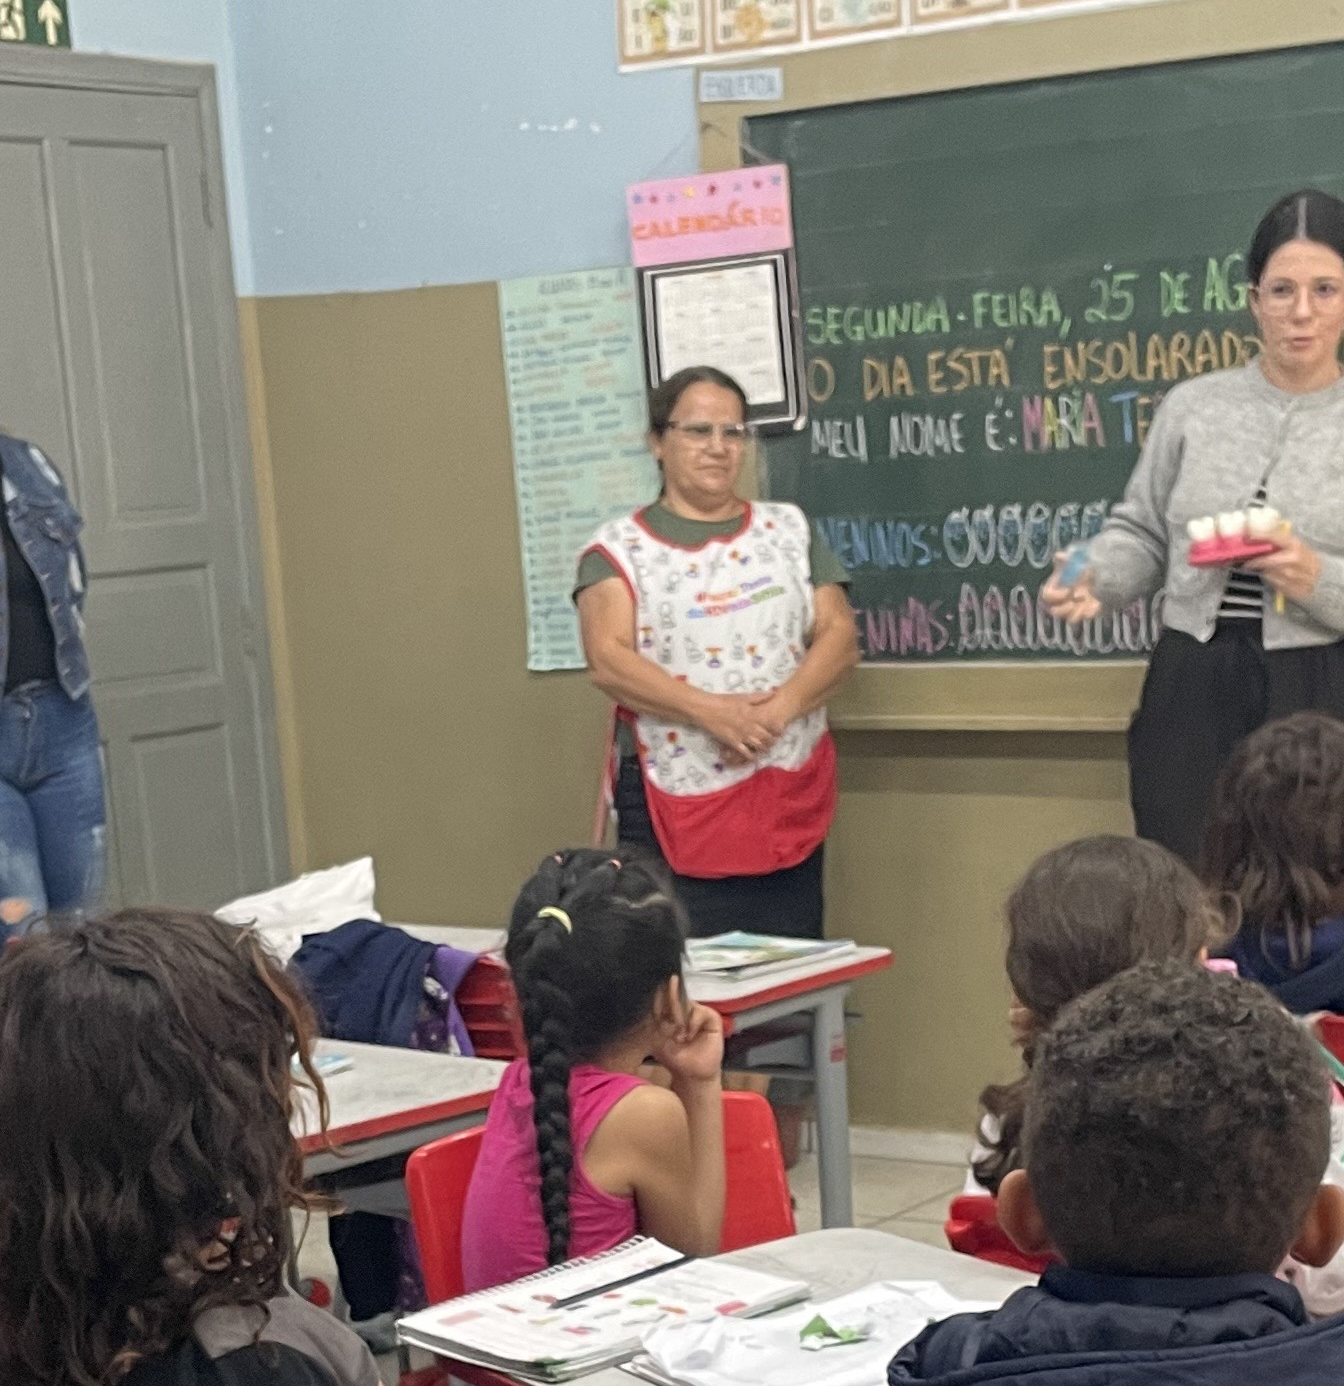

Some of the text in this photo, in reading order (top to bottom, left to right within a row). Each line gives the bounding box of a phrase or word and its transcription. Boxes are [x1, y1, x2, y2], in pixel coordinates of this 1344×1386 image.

[1160, 271, 1190, 317] DE
[807, 358, 835, 401] O
[863, 355, 913, 401] DIA
[812, 415, 868, 463] MEU
[890, 412, 965, 460] NOME
